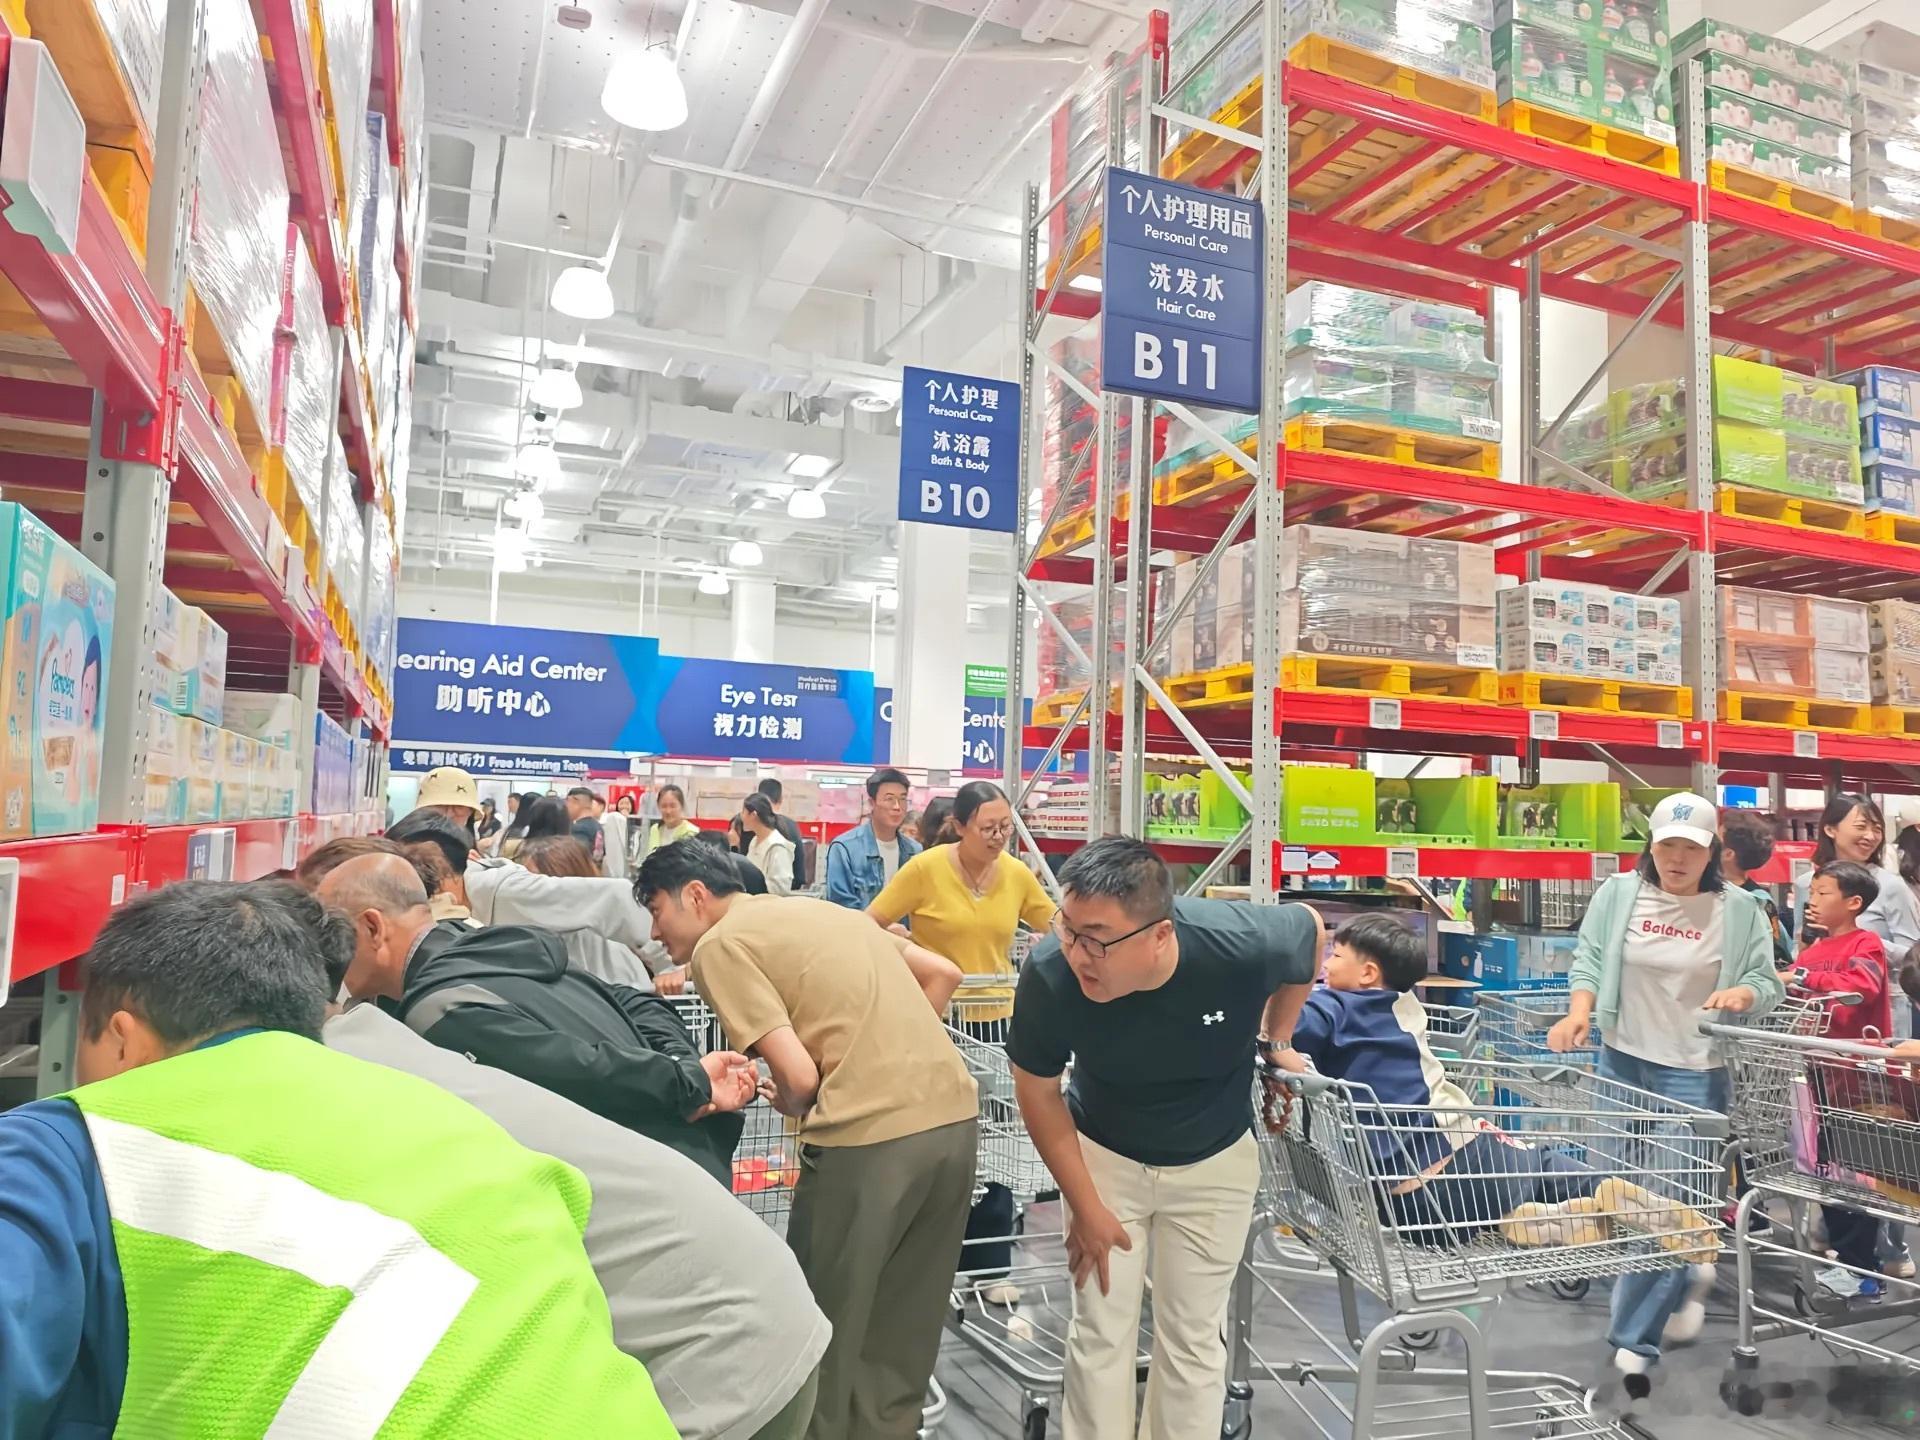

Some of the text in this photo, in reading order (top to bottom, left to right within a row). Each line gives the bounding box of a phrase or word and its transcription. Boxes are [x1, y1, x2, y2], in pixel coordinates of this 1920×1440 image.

[1120, 184, 1253, 241] 个人护理用品
[1144, 223, 1229, 255] Personal Care
[1148, 262, 1225, 303] 洗发水
[1157, 297, 1217, 322] Hair Care
[1134, 331, 1218, 391] B11
[924, 379, 1000, 410] 个人护理
[928, 404, 994, 423] Personal Care
[932, 430, 992, 458] 沐浴露
[931, 454, 990, 473] Bath & Body
[920, 481, 991, 519] B10
[397, 649, 608, 683] earing Aid Center
[435, 684, 552, 718] 助听中心
[720, 684, 756, 708] Eye
[713, 712, 803, 741] 视力检测
[488, 755, 514, 769] Free
[515, 756, 561, 773] Hearing
[1642, 920, 1702, 941] Balance
